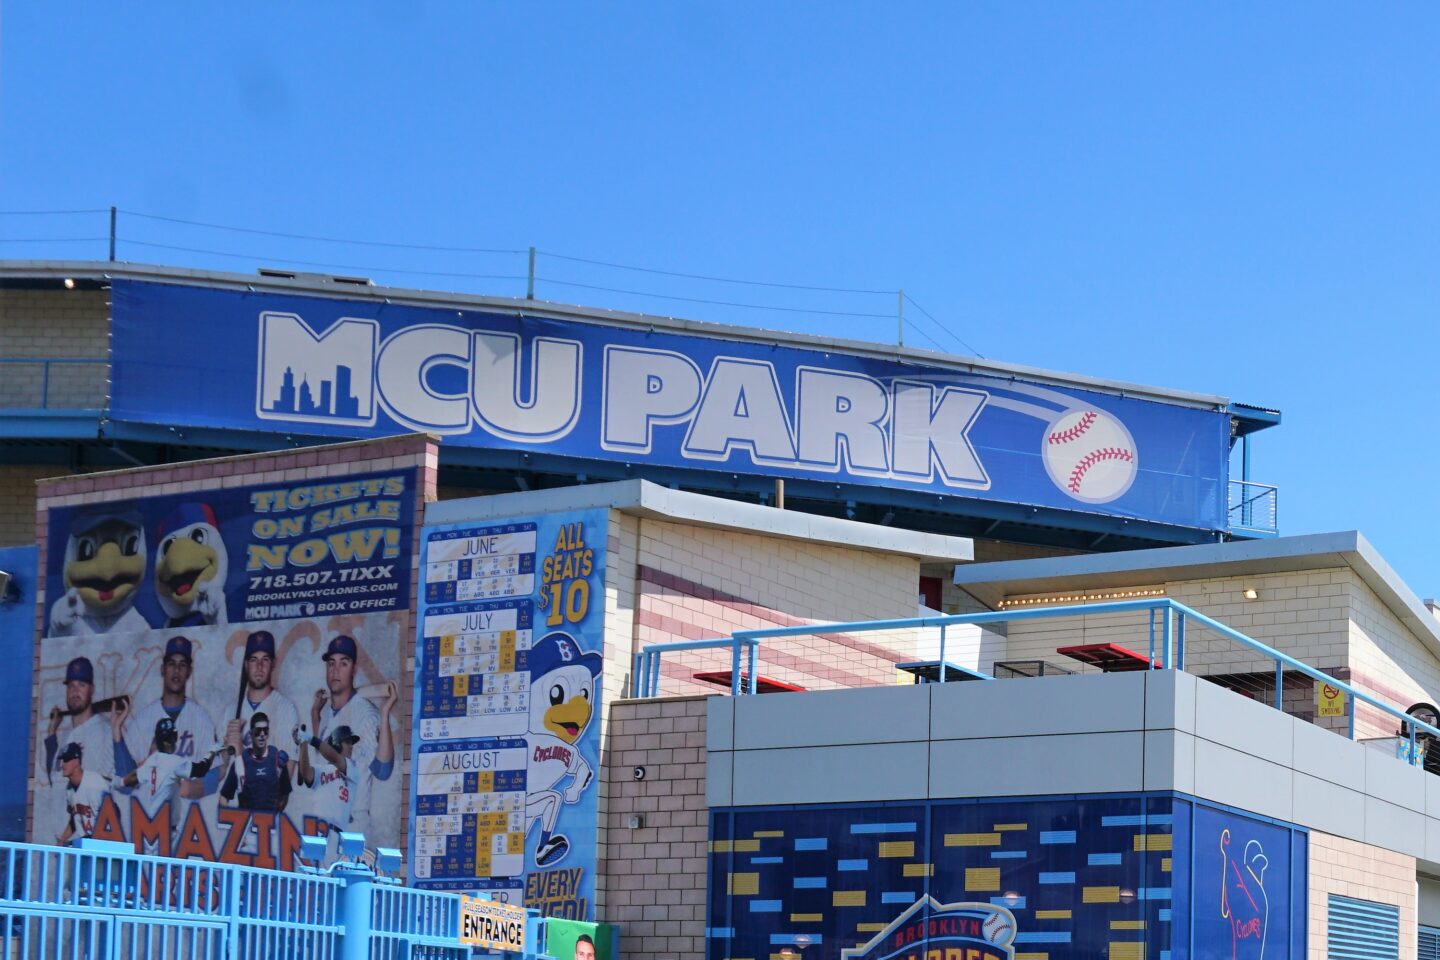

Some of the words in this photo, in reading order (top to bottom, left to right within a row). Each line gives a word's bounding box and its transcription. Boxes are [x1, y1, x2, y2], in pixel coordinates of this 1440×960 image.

[256, 311, 583, 443] MCU
[601, 343, 992, 492] PARK
[250, 475, 405, 513] TICKETS
[252, 515, 306, 539] ON
[310, 501, 401, 533] SALE
[246, 527, 401, 572] NOW!
[462, 537, 499, 556] JUNE
[554, 522, 585, 552] ALL
[249, 565, 394, 590] 718.507.TIXX
[542, 548, 593, 583] SEATS
[247, 582, 399, 602] BROOKLYNCYCLONES.COM
[537, 578, 590, 627] $10
[245, 606, 269, 621] MCU
[270, 603, 303, 619] PARK
[317, 601, 346, 612] BOX
[350, 598, 396, 609] OFFICE
[461, 613, 493, 631] JULY
[442, 751, 500, 770] AUGUST
[525, 868, 582, 899] EVERY
[464, 914, 522, 945] ENTRANCE
[896, 919, 980, 947] BROOKLYN
